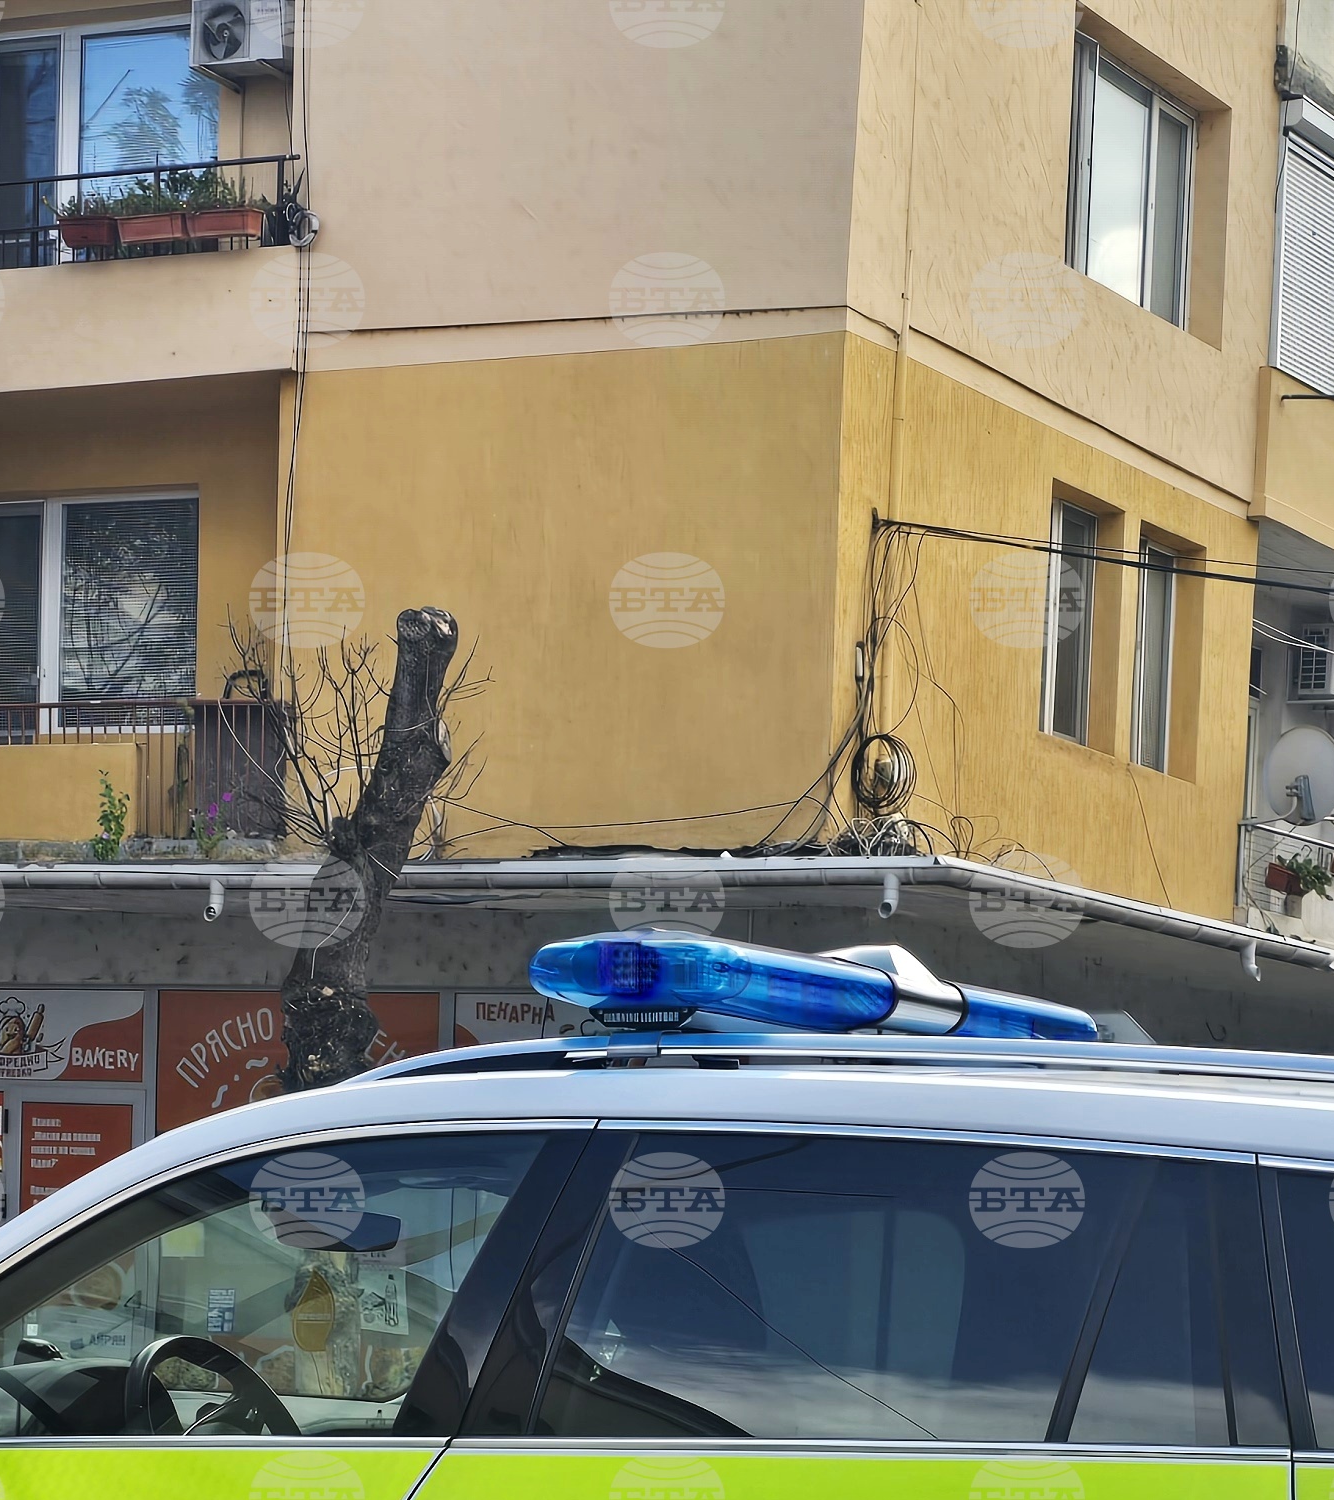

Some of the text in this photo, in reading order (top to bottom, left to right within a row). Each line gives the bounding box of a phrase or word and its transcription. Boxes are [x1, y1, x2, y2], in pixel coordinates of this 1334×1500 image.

[475, 1001, 556, 1024] ПЕКАРНА
[71, 1046, 139, 1072] BAKERY
[175, 1007, 274, 1089] ПРЯСНО
